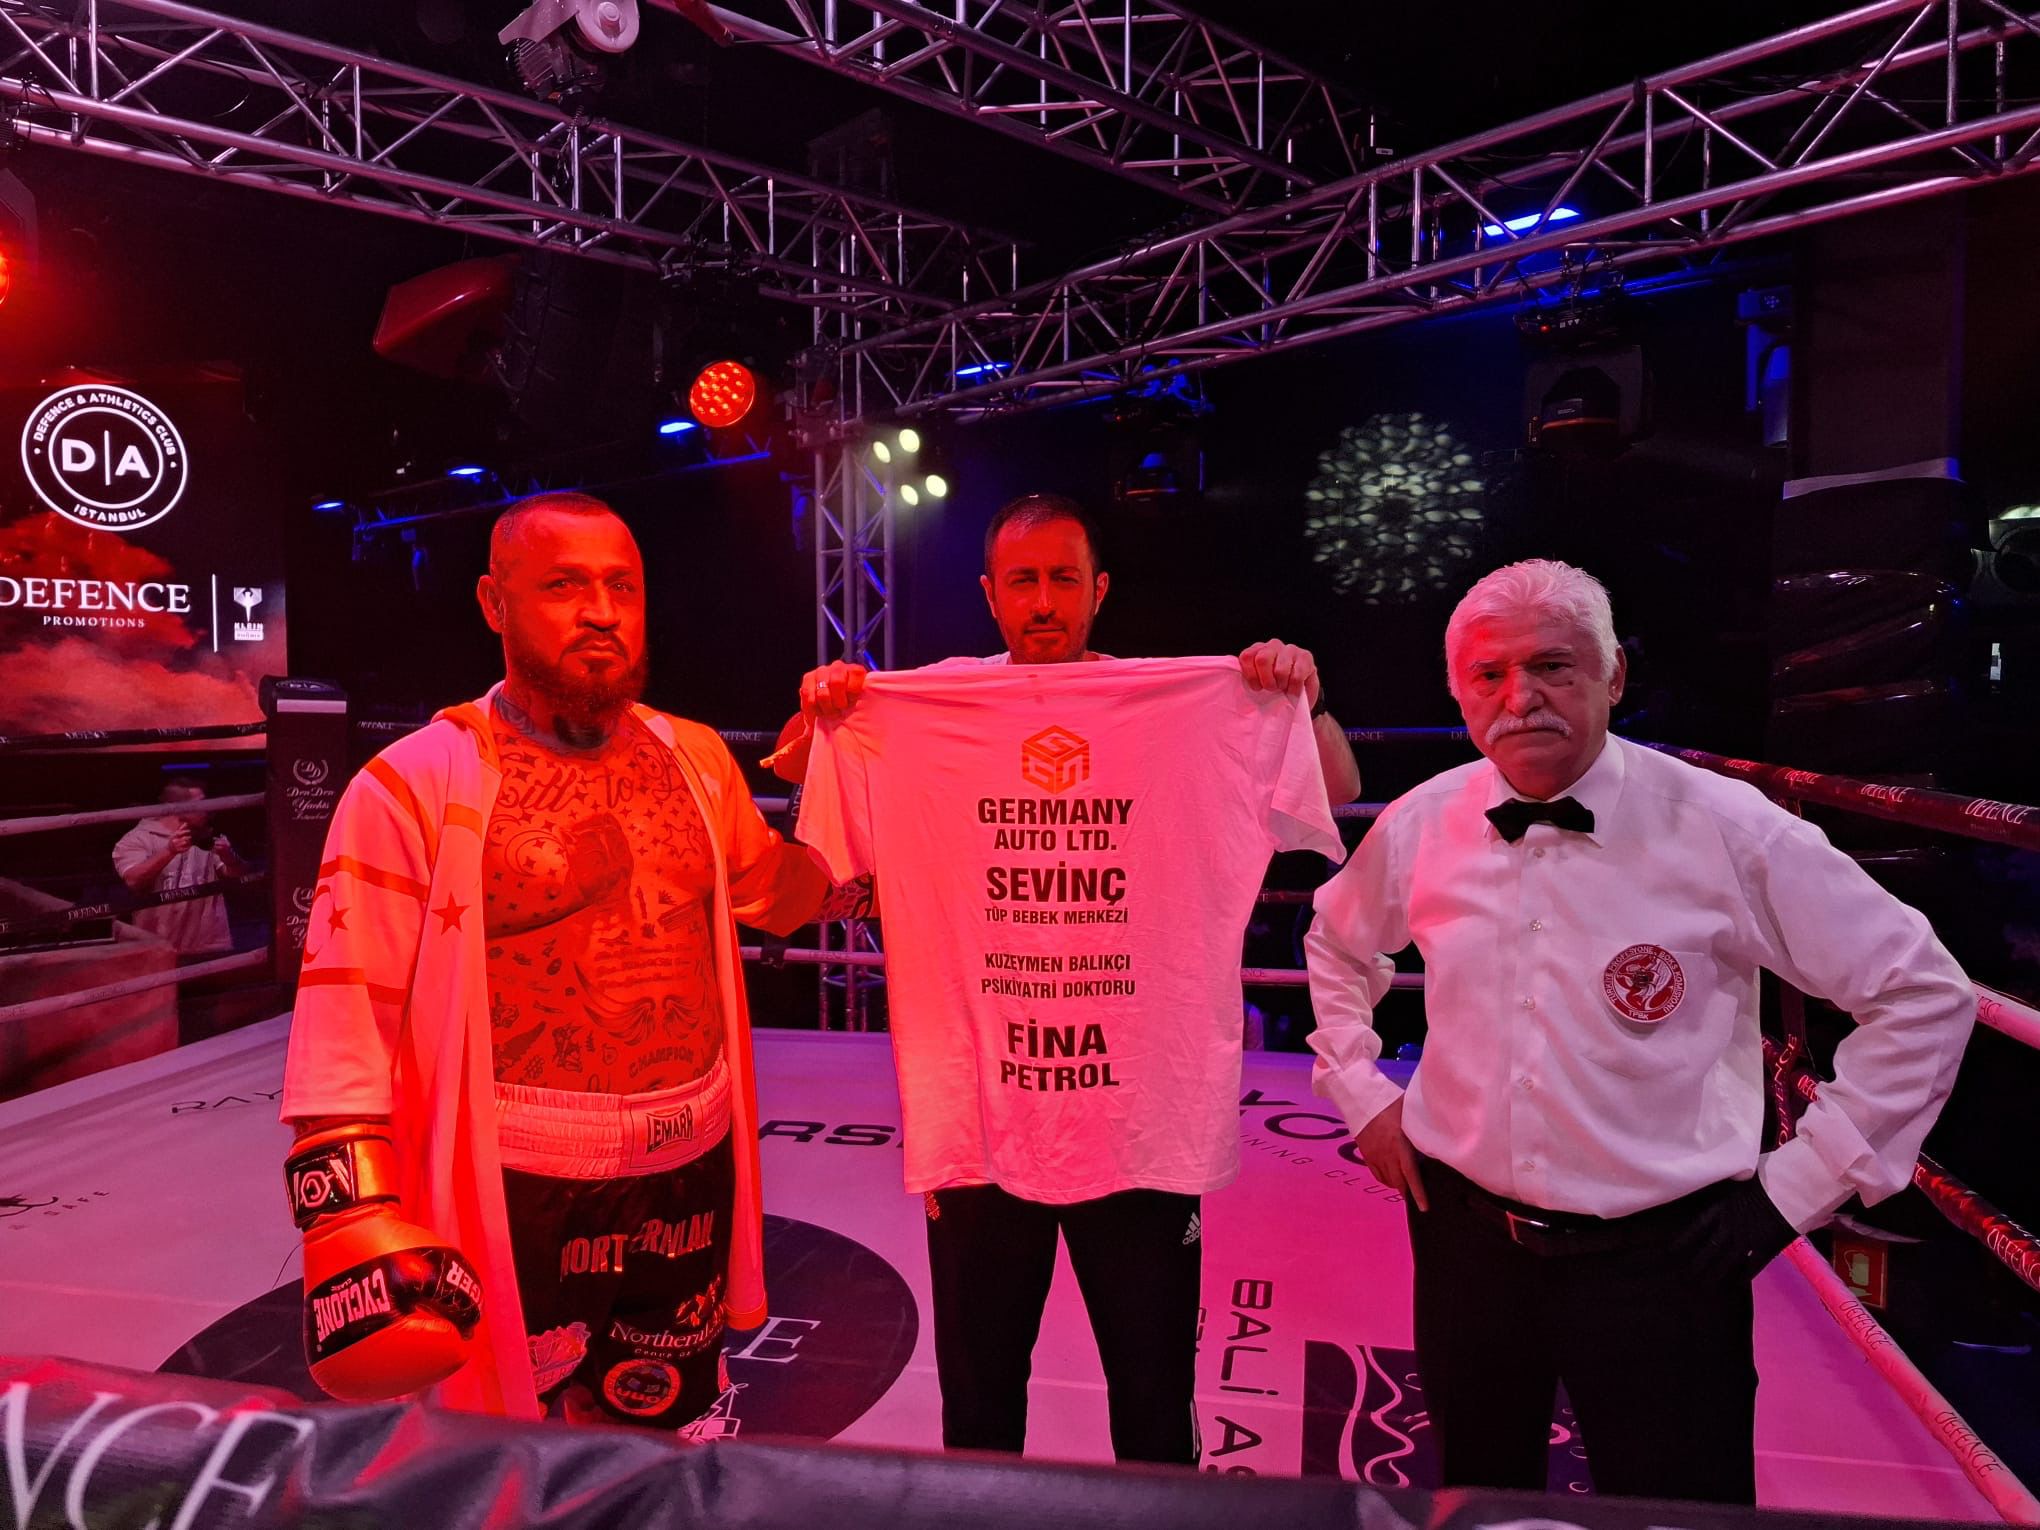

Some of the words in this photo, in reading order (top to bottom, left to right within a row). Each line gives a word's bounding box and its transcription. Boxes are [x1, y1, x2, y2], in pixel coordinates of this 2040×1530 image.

[33, 397, 75, 442] DEFENCE
[77, 394, 86, 405] &
[89, 393, 157, 426] ATHLETICS
[155, 424, 176, 456] CLUB
[73, 503, 147, 523] ISTANBUL
[43, 614, 146, 629] PROMOTIONS
[977, 797, 1134, 825] GERMANY
[993, 828, 1057, 851] AUTO
[1066, 829, 1117, 851] LTD.
[985, 860, 1127, 907] SEVİNÇ
[1012, 909, 1059, 925] BEBEK
[1063, 907, 1129, 925] MERKEZİ
[984, 952, 1063, 973] KUZEYMEN
[1068, 954, 1131, 972] BALIKÇI
[1062, 979, 1136, 999] DOKTORU
[1007, 1018, 1108, 1058] FİNA
[1000, 1059, 1120, 1092] PETROL
[1324, 1169, 1404, 1203] CLUB
[313, 1268, 391, 1343] CYCLONE
[1935, 1411, 2003, 1478] DEFENCE
